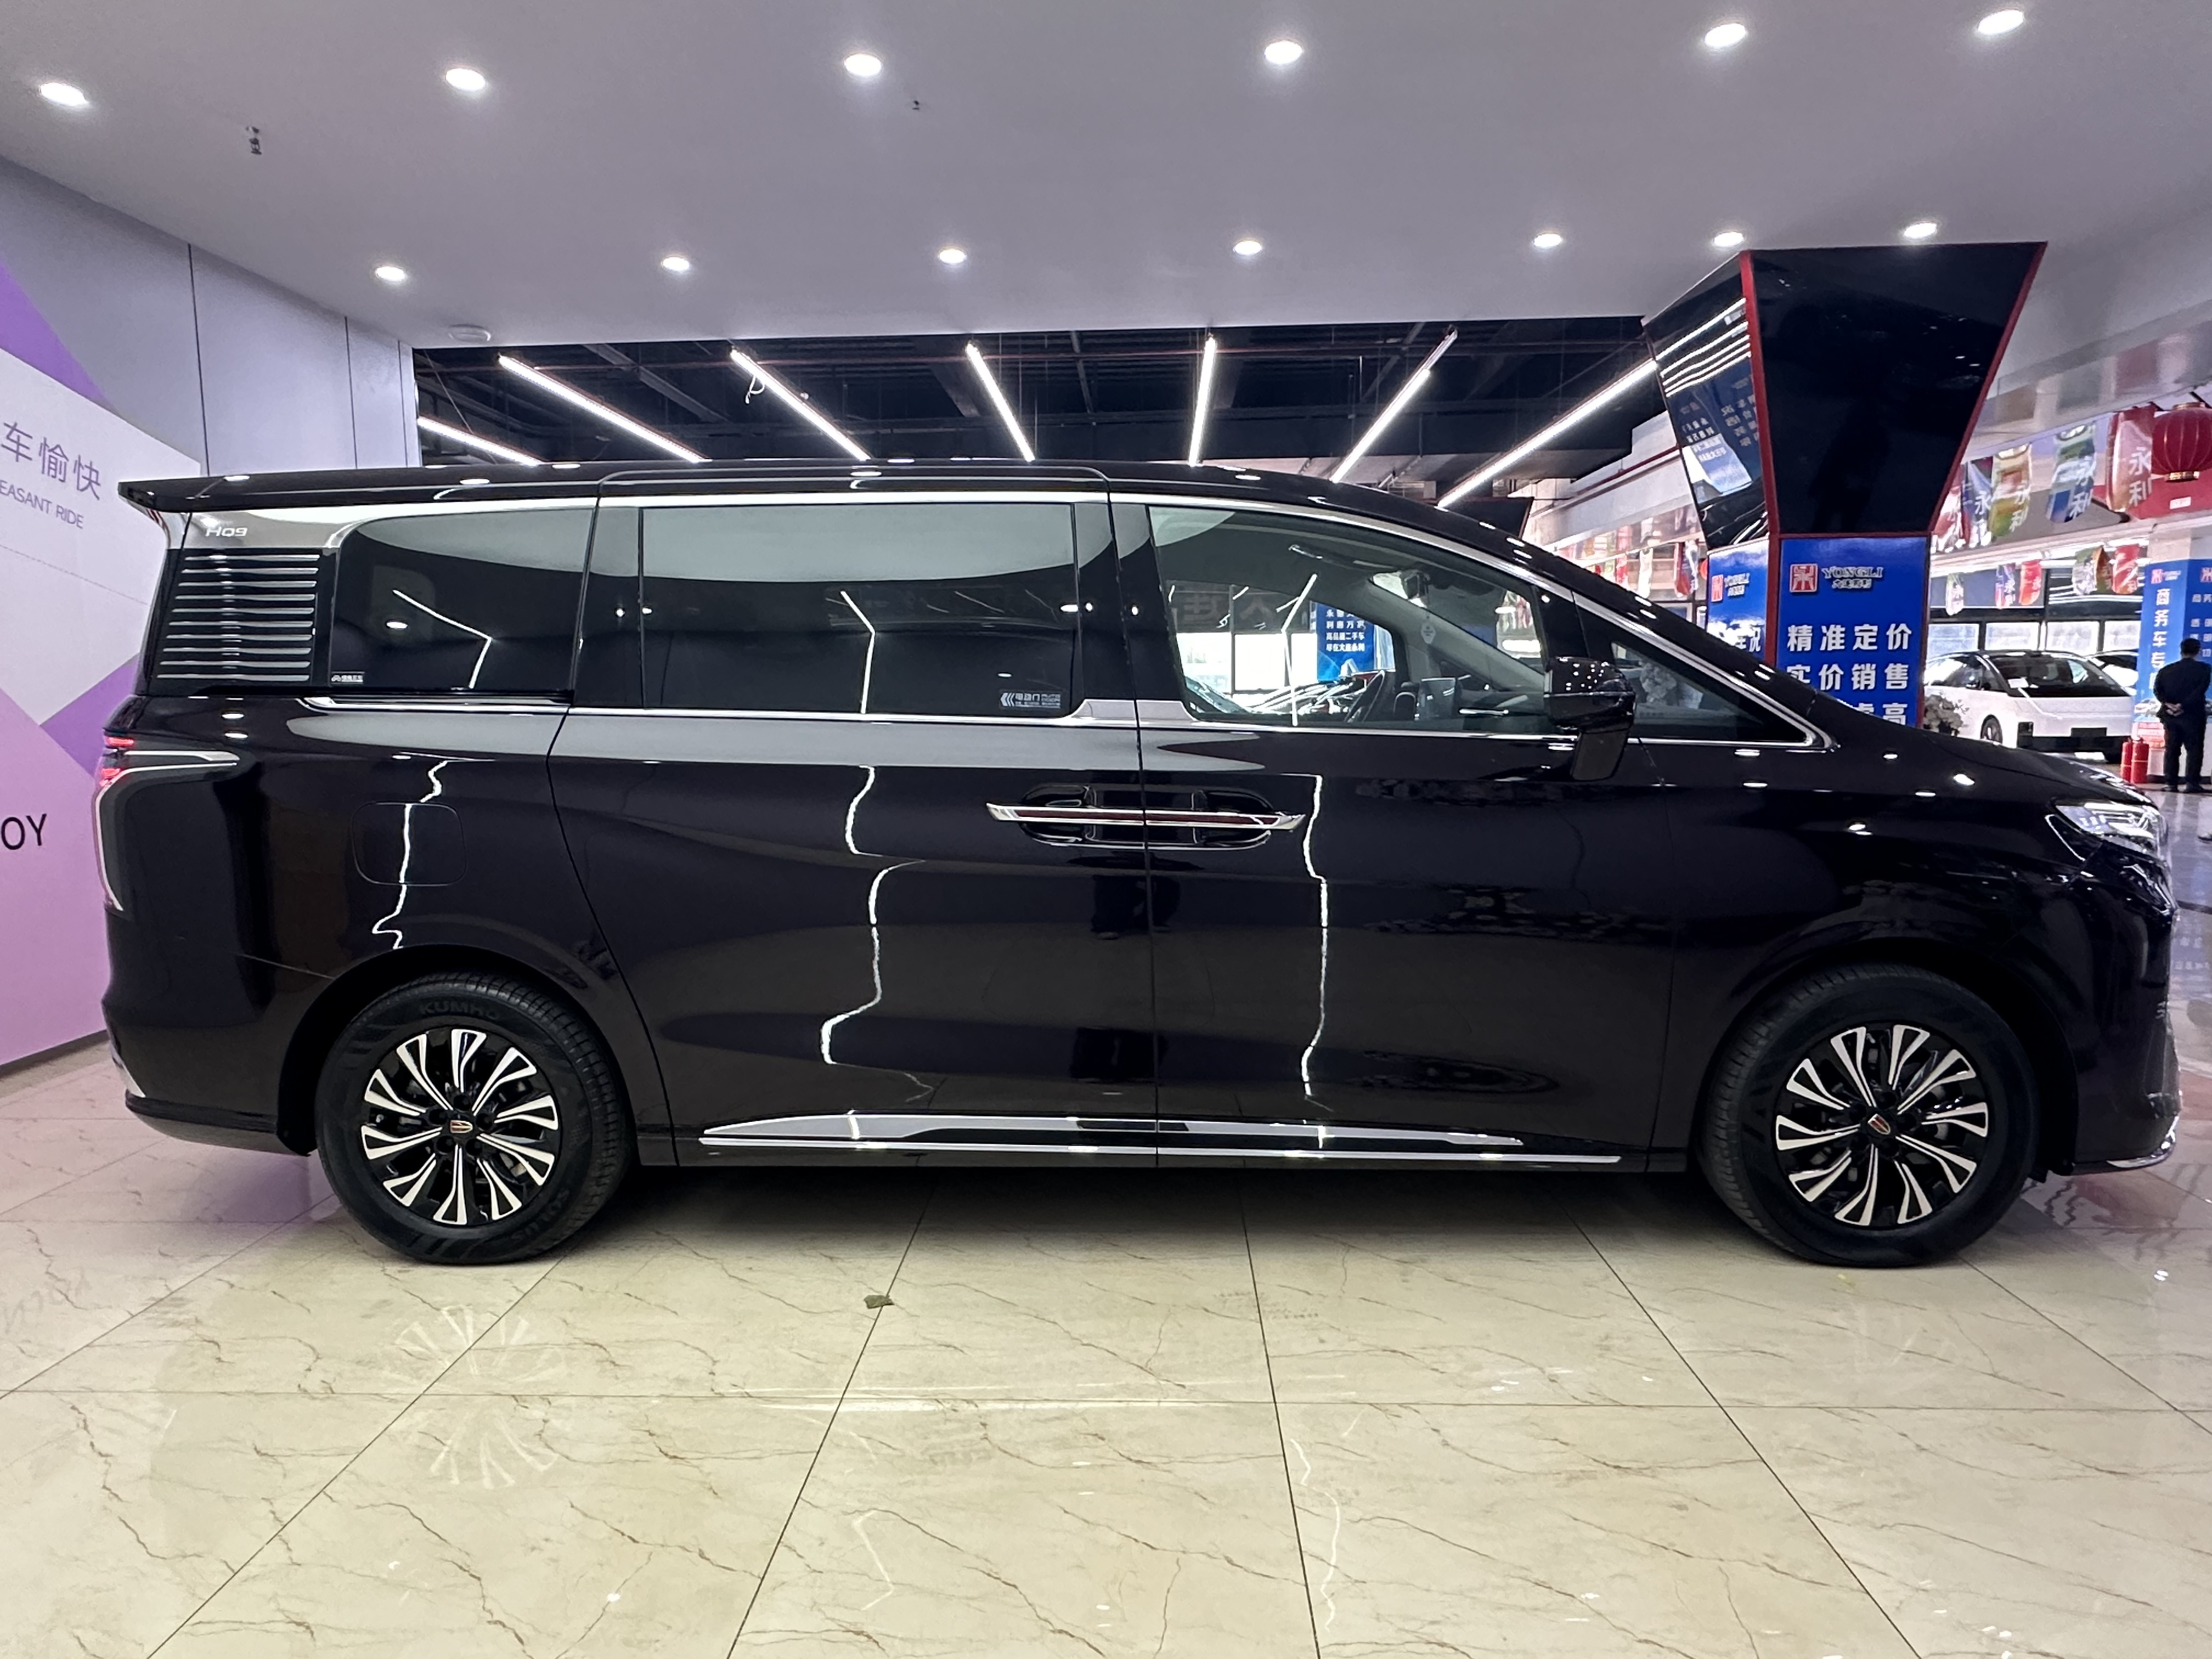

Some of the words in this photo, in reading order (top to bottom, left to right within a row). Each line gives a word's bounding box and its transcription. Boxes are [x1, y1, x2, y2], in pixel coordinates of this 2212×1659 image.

[1, 421, 101, 500] 车愉快
[0, 479, 52, 514] EASANT
[56, 504, 84, 529] RIDE
[205, 527, 248, 538] HQ9
[1821, 566, 1884, 579] YONGLI
[1787, 623, 1912, 652] 精准定价
[2148, 588, 2170, 690] 商务车专
[1786, 663, 1909, 691] 实价销售
[1, 813, 47, 850] OY
